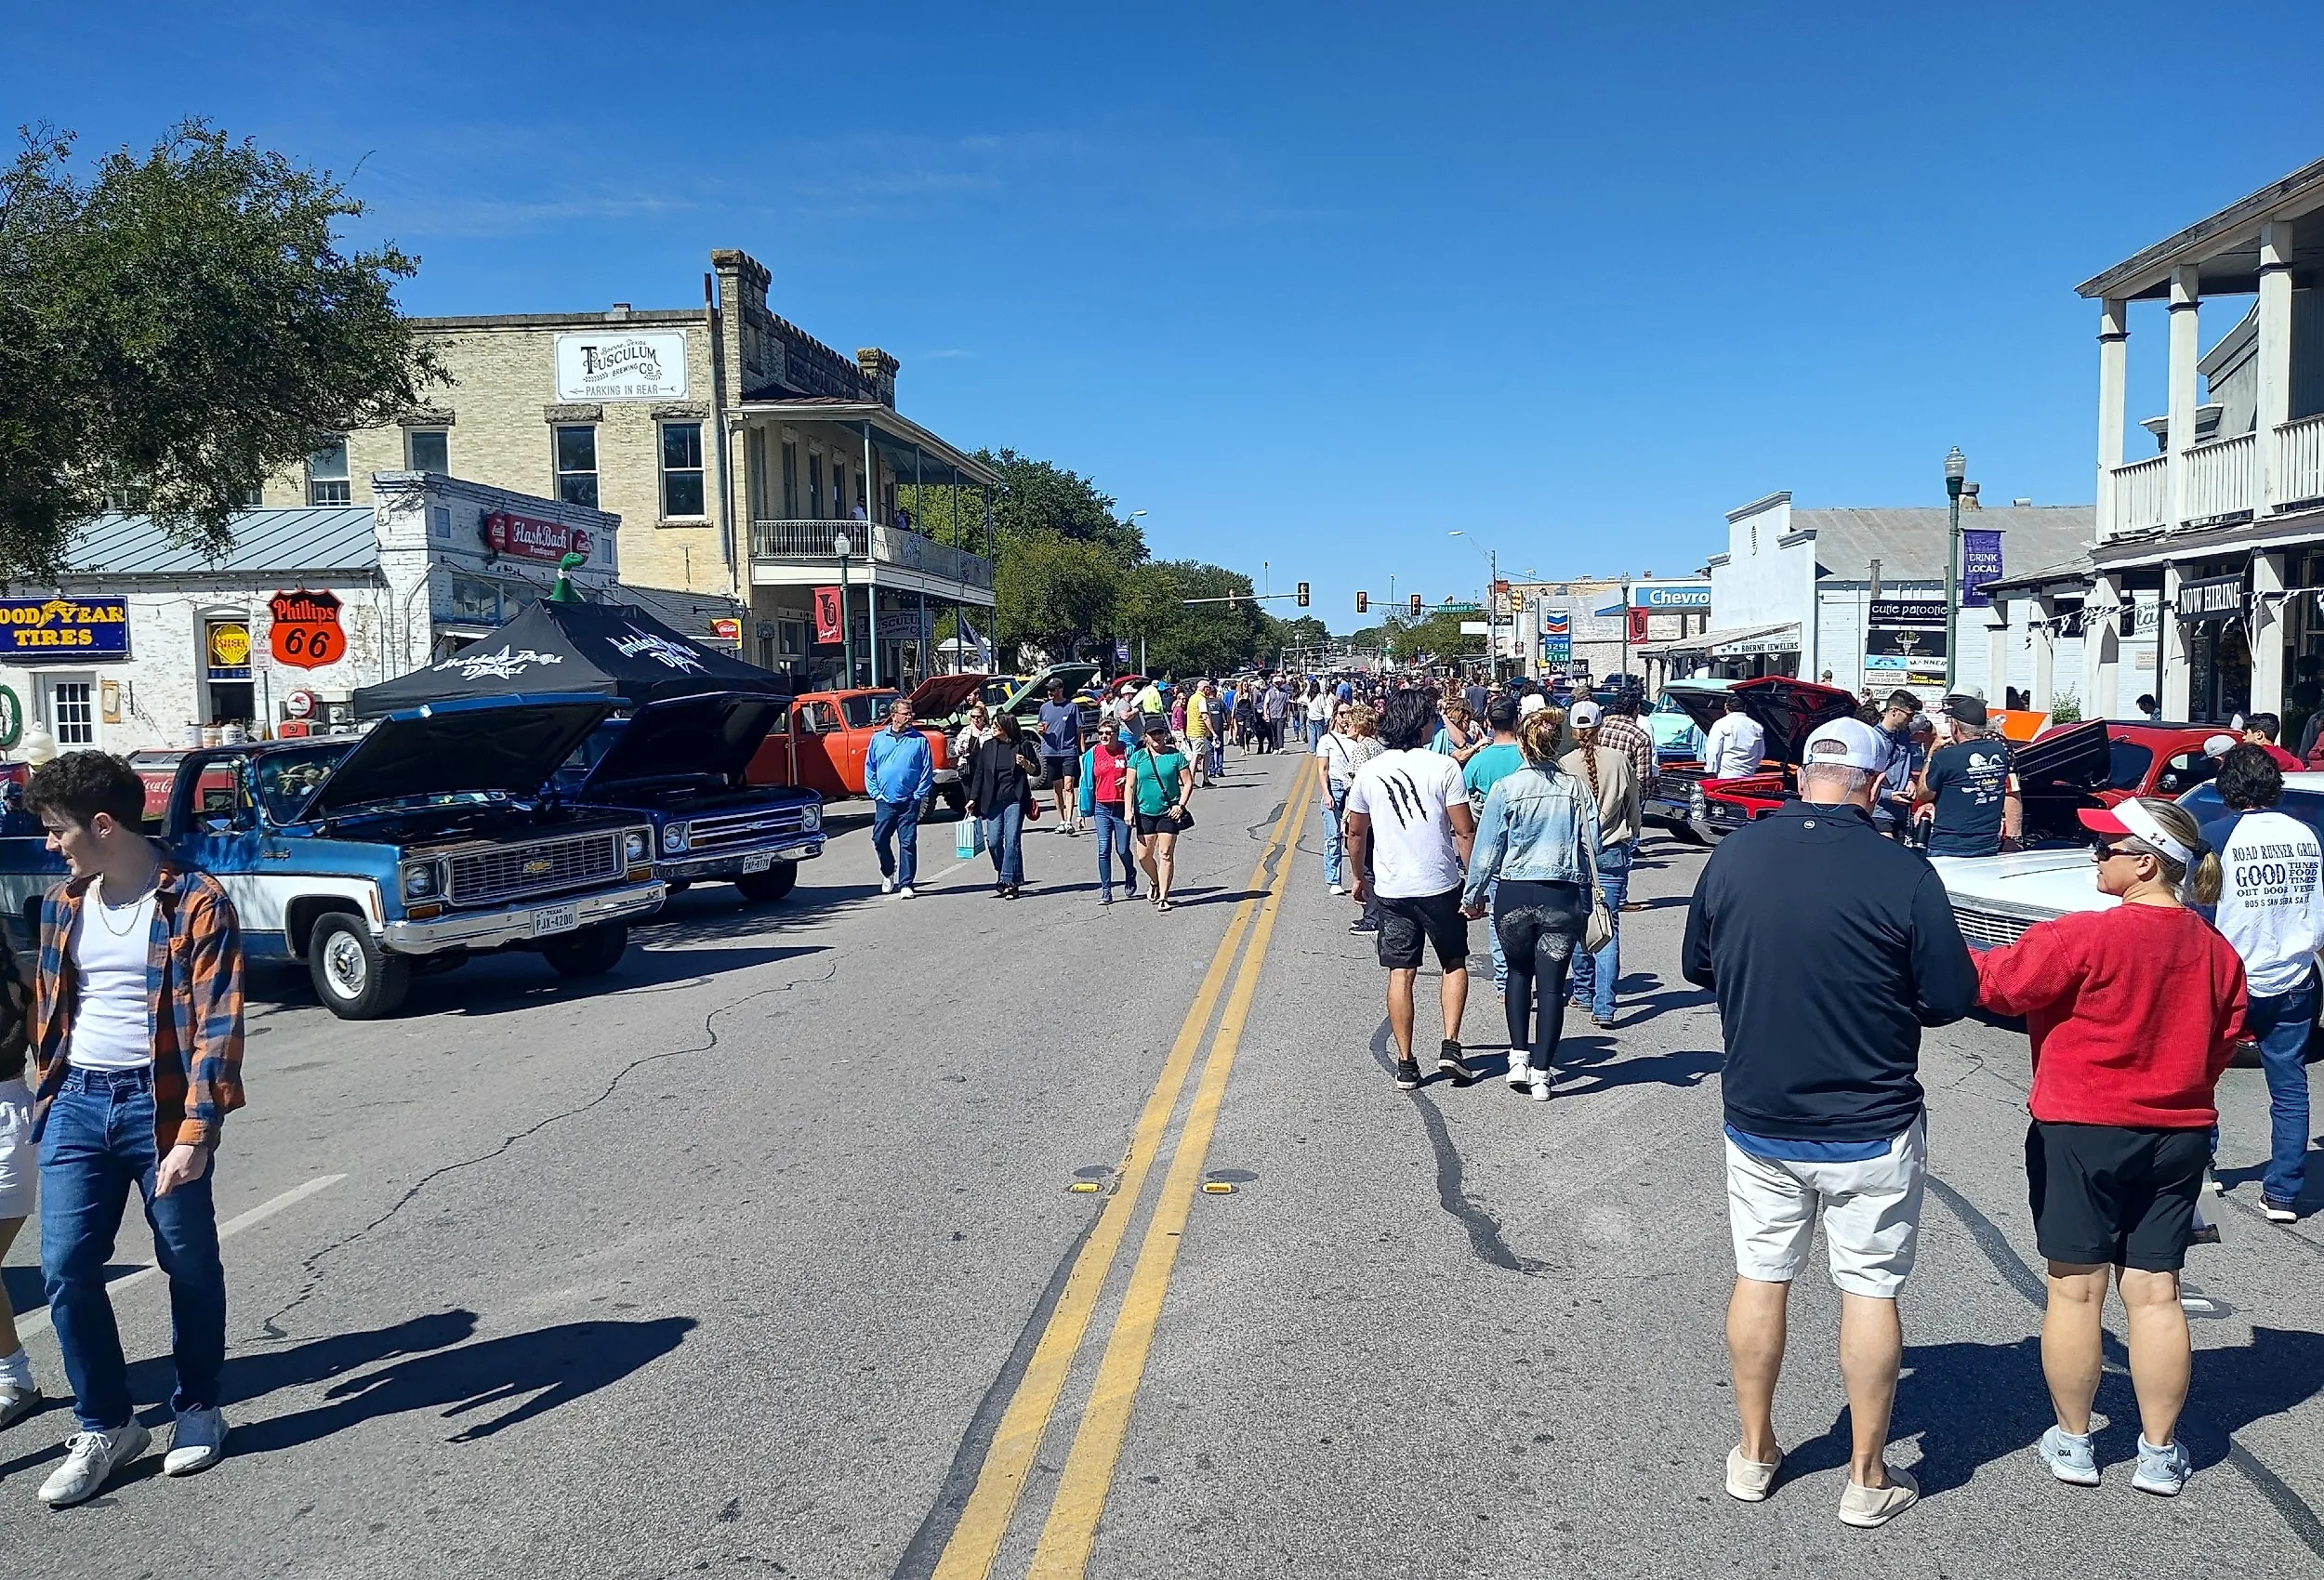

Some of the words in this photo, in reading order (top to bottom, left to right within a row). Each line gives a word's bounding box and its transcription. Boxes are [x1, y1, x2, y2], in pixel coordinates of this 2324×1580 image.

[581, 347, 661, 374] TUSCULUM
[612, 363, 639, 376] BREWING
[586, 386, 621, 396] PARKING
[625, 385, 632, 395] IN
[637, 385, 658, 395] REAR
[1969, 553, 1998, 562] DRINK
[1967, 564, 1999, 573] LOCAL
[1649, 589, 1710, 605] Chevro
[2180, 586, 2202, 614] NOW
[2204, 581, 2241, 612] HIRING
[273, 599, 335, 625] Phillips
[858, 614, 930, 634] TUSCULU
[13, 628, 93, 646] TIRES
[217, 639, 247, 649] SHELL
[284, 627, 331, 658] 66
[1741, 643, 1765, 652] BOERNE
[1768, 642, 1799, 651] JEWELERS
[2232, 846, 2258, 862] ROAD
[2260, 844, 2294, 860] RUNNER
[2296, 843, 2320, 857] GRILL
[2235, 863, 2286, 887] GOOD
[2237, 888, 2258, 897] OUT
[2264, 887, 2289, 895] DOOR
[2244, 899, 2259, 908] 805
[2260, 899, 2265, 907] S
[536, 913, 574, 930] PJX-4200
